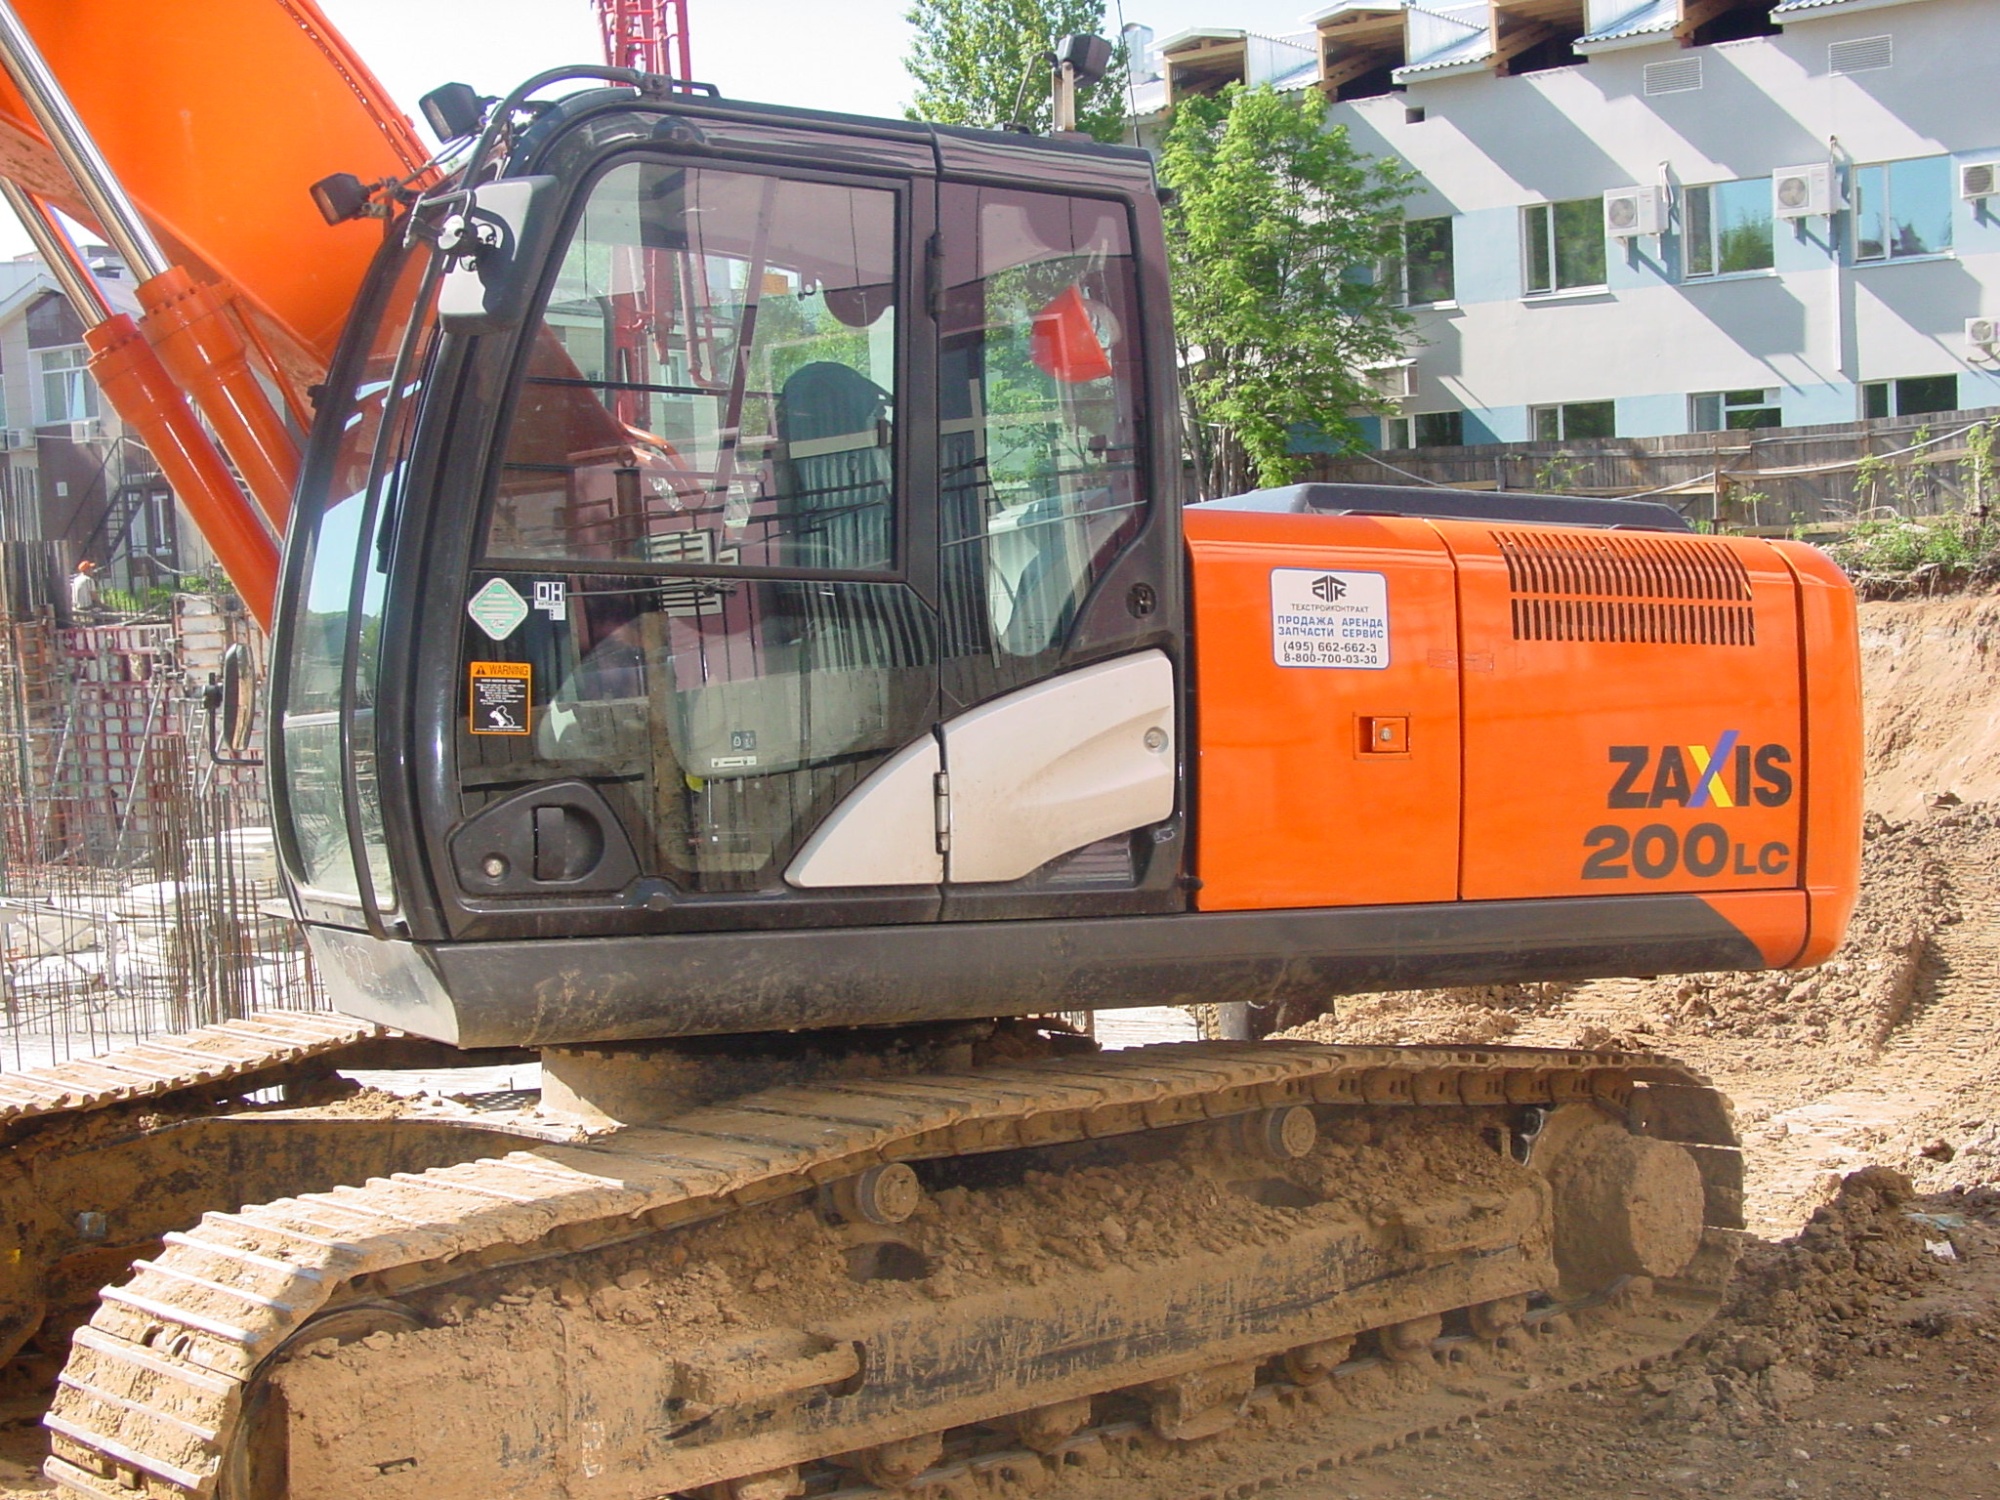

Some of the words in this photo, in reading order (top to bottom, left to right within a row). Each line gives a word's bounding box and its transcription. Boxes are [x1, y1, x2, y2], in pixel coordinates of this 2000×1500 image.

[1277, 615, 1334, 626] ПРОДАЖА
[1341, 618, 1383, 628] АРЕНДА
[1278, 626, 1334, 637] ЗАПЧАСТИ
[1342, 628, 1384, 639] СЕРВИС
[1283, 641, 1314, 653] (495)
[1317, 642, 1377, 653] 662-662-3
[1283, 653, 1378, 664] 8-800-700-03-30
[489, 664, 529, 676] WARNING
[1607, 730, 1793, 809] ZAXIS
